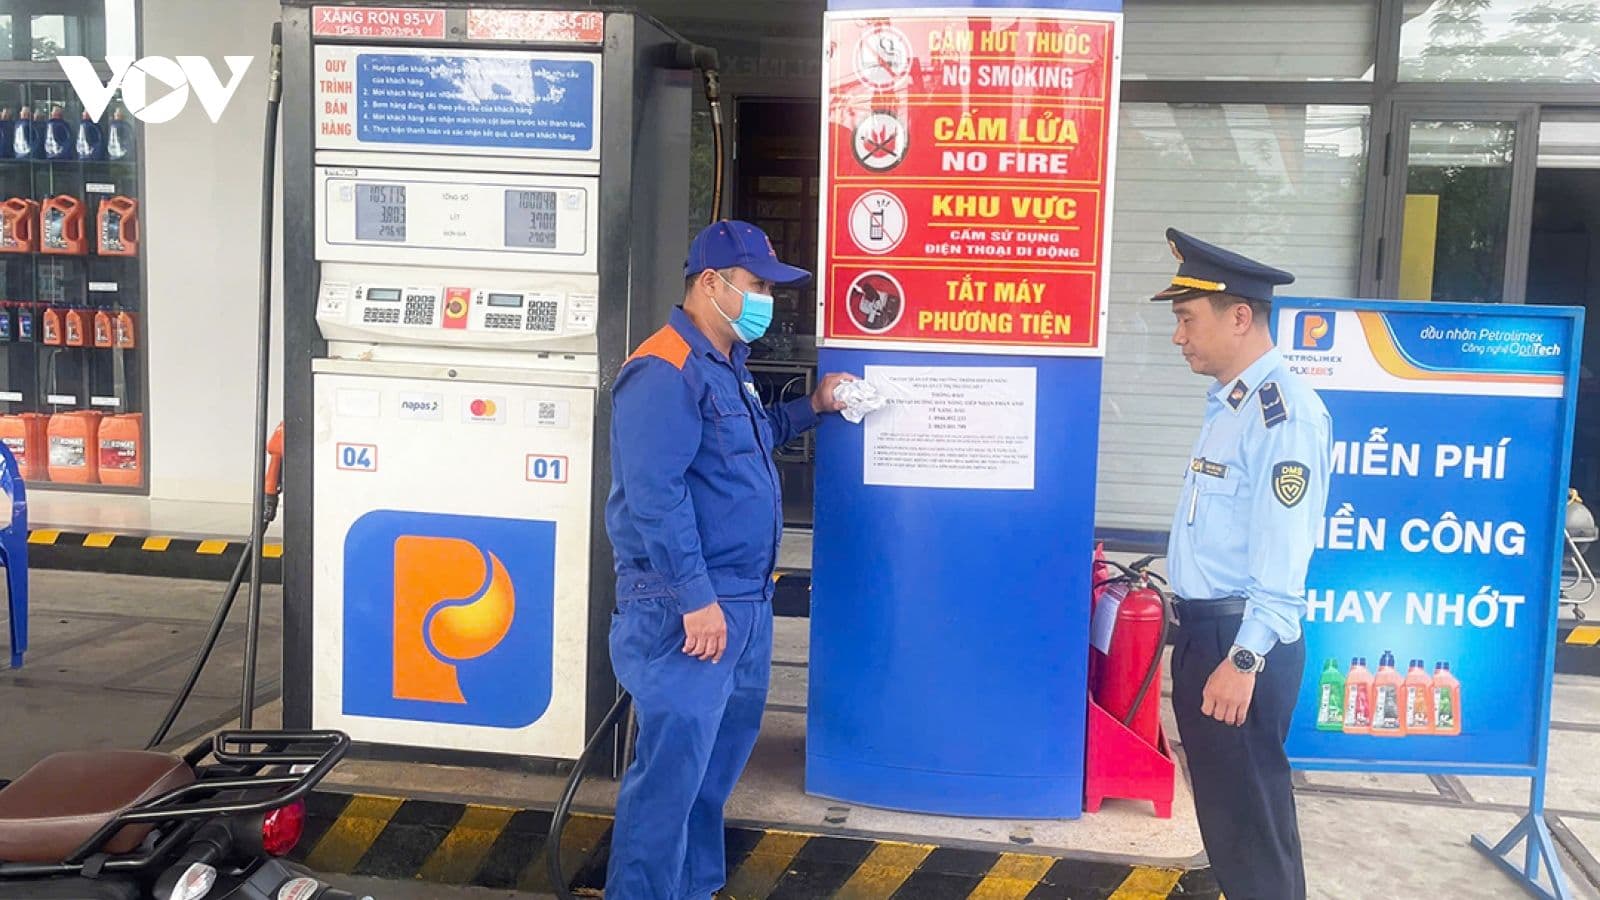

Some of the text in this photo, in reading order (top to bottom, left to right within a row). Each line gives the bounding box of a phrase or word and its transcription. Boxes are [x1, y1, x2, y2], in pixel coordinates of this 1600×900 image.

[322, 9, 435, 25] XĂNG RON 95-V
[928, 23, 974, 52] CẤM
[1025, 25, 1091, 55] THUỐC
[325, 59, 346, 72] QUY
[320, 77, 352, 94] TRÌNH
[943, 64, 1074, 90] NO SMOKING
[325, 99, 348, 115] BÁN
[321, 119, 352, 136] HÀNG
[934, 108, 1079, 144] CẤM LỬA
[942, 151, 1068, 174] NO FIRE
[932, 195, 1077, 224] KHU VỰC
[950, 227, 1060, 244] CẤM SỬ DỤNG
[925, 242, 1080, 259] ĐIỆN THOẠI DI ĐỘNG
[947, 274, 1046, 304] TẮT MÁY
[919, 309, 1071, 339] PHƯƠNG TIỆN
[1420, 325, 1444, 340] dầu
[1479, 328, 1544, 343] Petrolimex
[1461, 342, 1486, 355] Công
[1509, 341, 1561, 357] OptiTech
[401, 400, 430, 411] napas
[343, 446, 371, 468] 04
[1434, 437, 1512, 479] PHÍ
[533, 458, 561, 480] 01
[1314, 501, 1526, 556] IỀN CÔNG
[1306, 585, 1526, 629] HAY NHỚT
